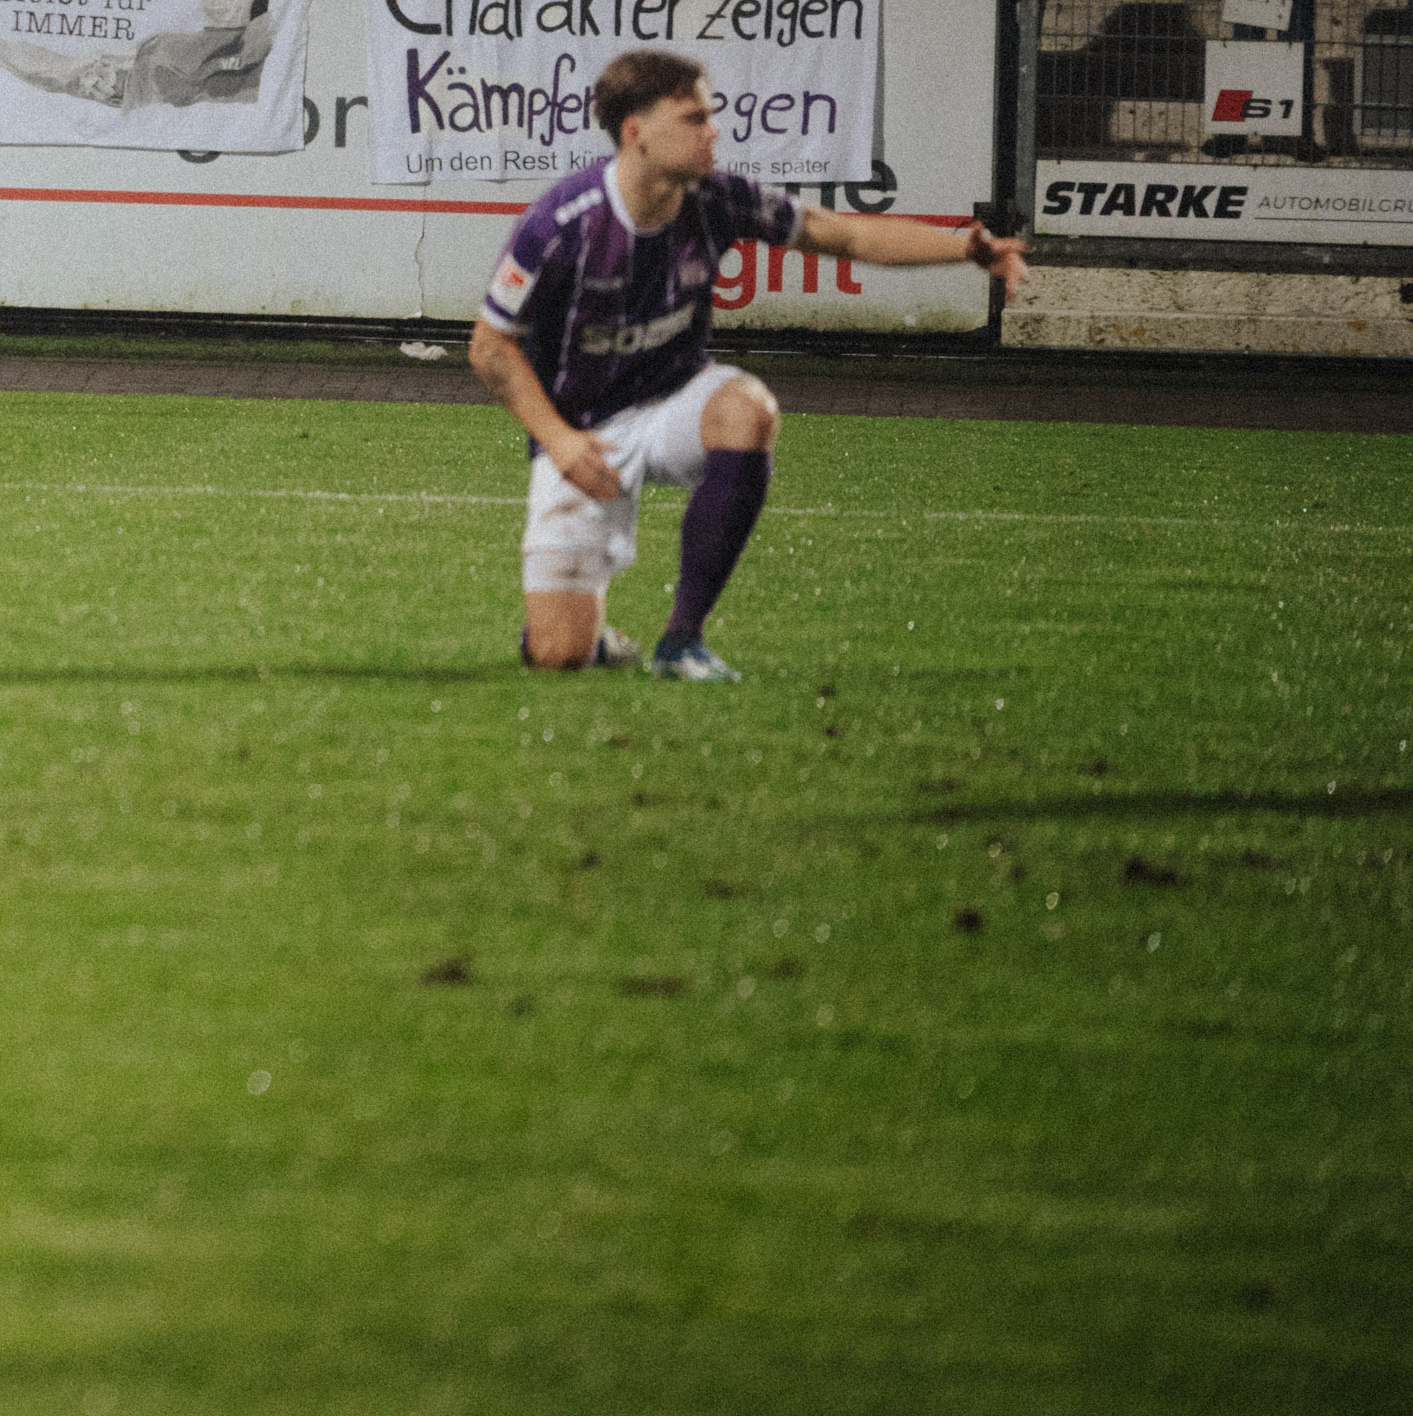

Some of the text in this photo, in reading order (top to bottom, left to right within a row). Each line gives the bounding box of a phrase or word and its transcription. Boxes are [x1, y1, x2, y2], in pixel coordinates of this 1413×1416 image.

[11, 10, 136, 41] IMMER
[406, 153, 443, 174] Um
[450, 152, 492, 171] den
[504, 150, 558, 171] Rest
[728, 159, 761, 175] uns
[1042, 180, 1249, 219] STARKE
